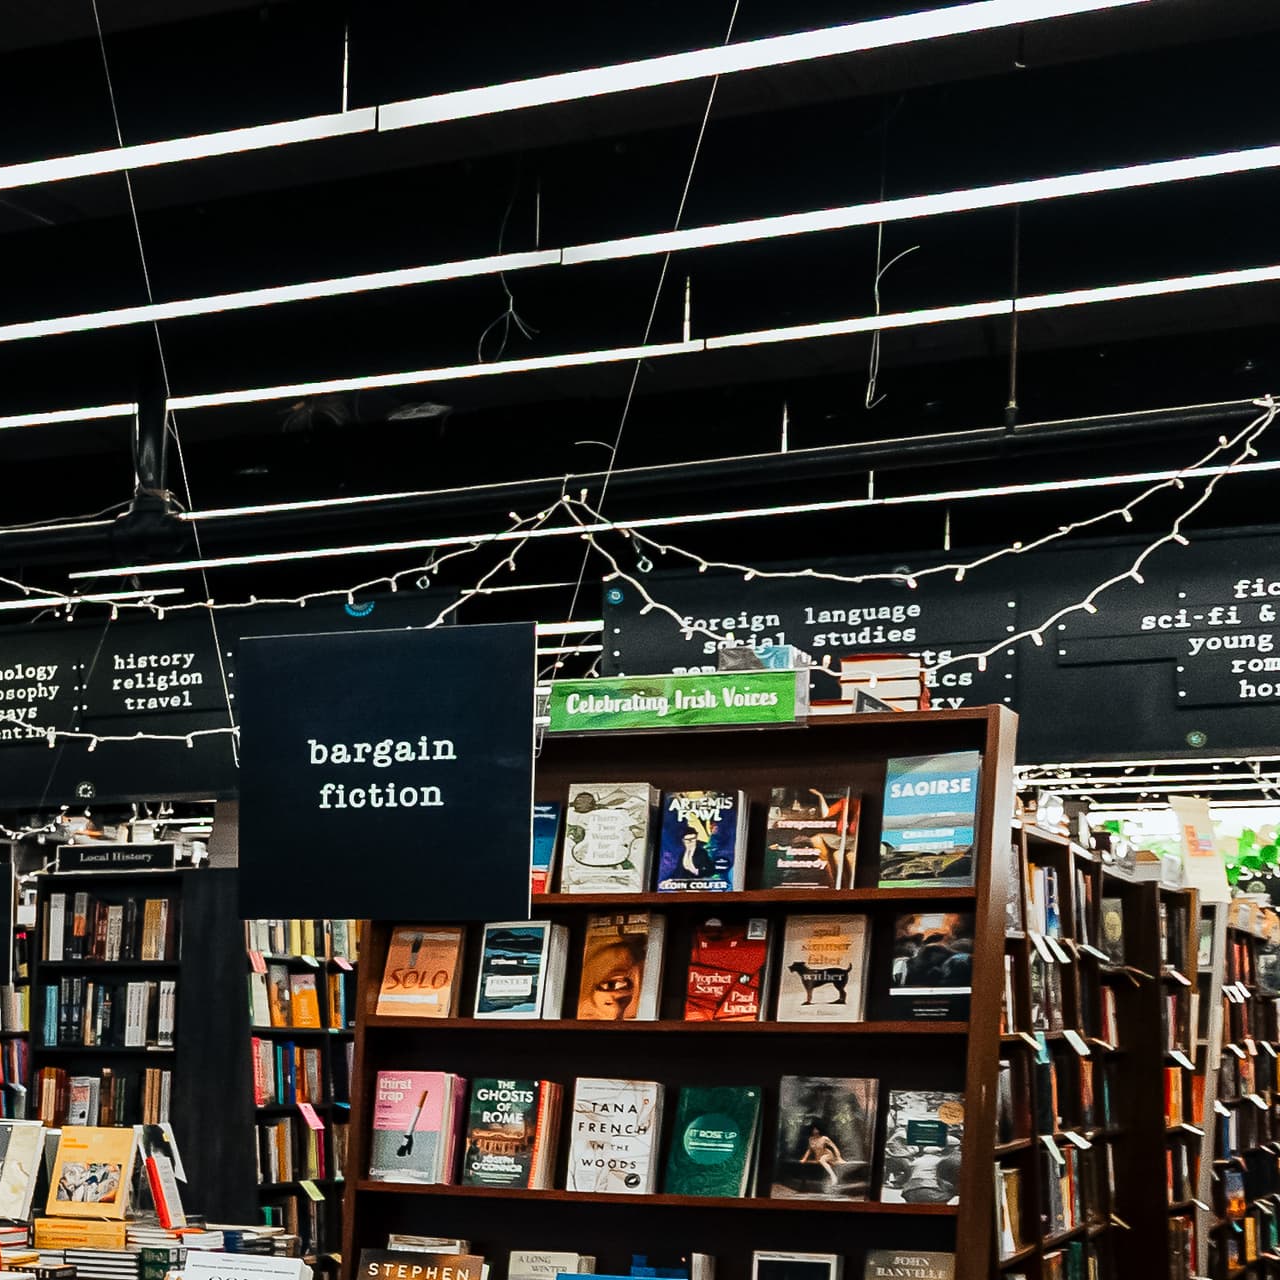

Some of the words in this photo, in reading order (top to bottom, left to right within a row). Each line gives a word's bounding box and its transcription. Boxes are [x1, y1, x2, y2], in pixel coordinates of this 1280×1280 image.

[681, 610, 780, 631] foreign
[804, 602, 921, 626] language
[1141, 606, 1241, 630] sci-fi
[1258, 604, 1276, 623] &
[813, 626, 916, 647] studies
[1189, 633, 1273, 655] young
[114, 652, 195, 670] history
[111, 669, 202, 692] religion
[124, 691, 192, 711] travel
[565, 692, 669, 716] Celebrating
[674, 688, 716, 710] Irish
[722, 686, 778, 708] Voices
[307, 736, 457, 768] bargain
[318, 782, 444, 809] fiction
[890, 777, 972, 798] SAOIRSE
[669, 794, 734, 811] ARTEMIS
[79, 852, 110, 863] Local
[112, 850, 156, 865] History
[691, 972, 731, 986] Prophet
[695, 985, 724, 996] Song
[731, 991, 754, 1002] Paul
[724, 1001, 757, 1014] Lynch
[497, 1080, 516, 1089] THE
[476, 1089, 534, 1103] GHOSTS
[496, 1102, 512, 1112] OF
[591, 1101, 639, 1114] TANA
[482, 1111, 524, 1125] ROME
[578, 1121, 647, 1136] FRENCH
[581, 1157, 637, 1170] WOODS
